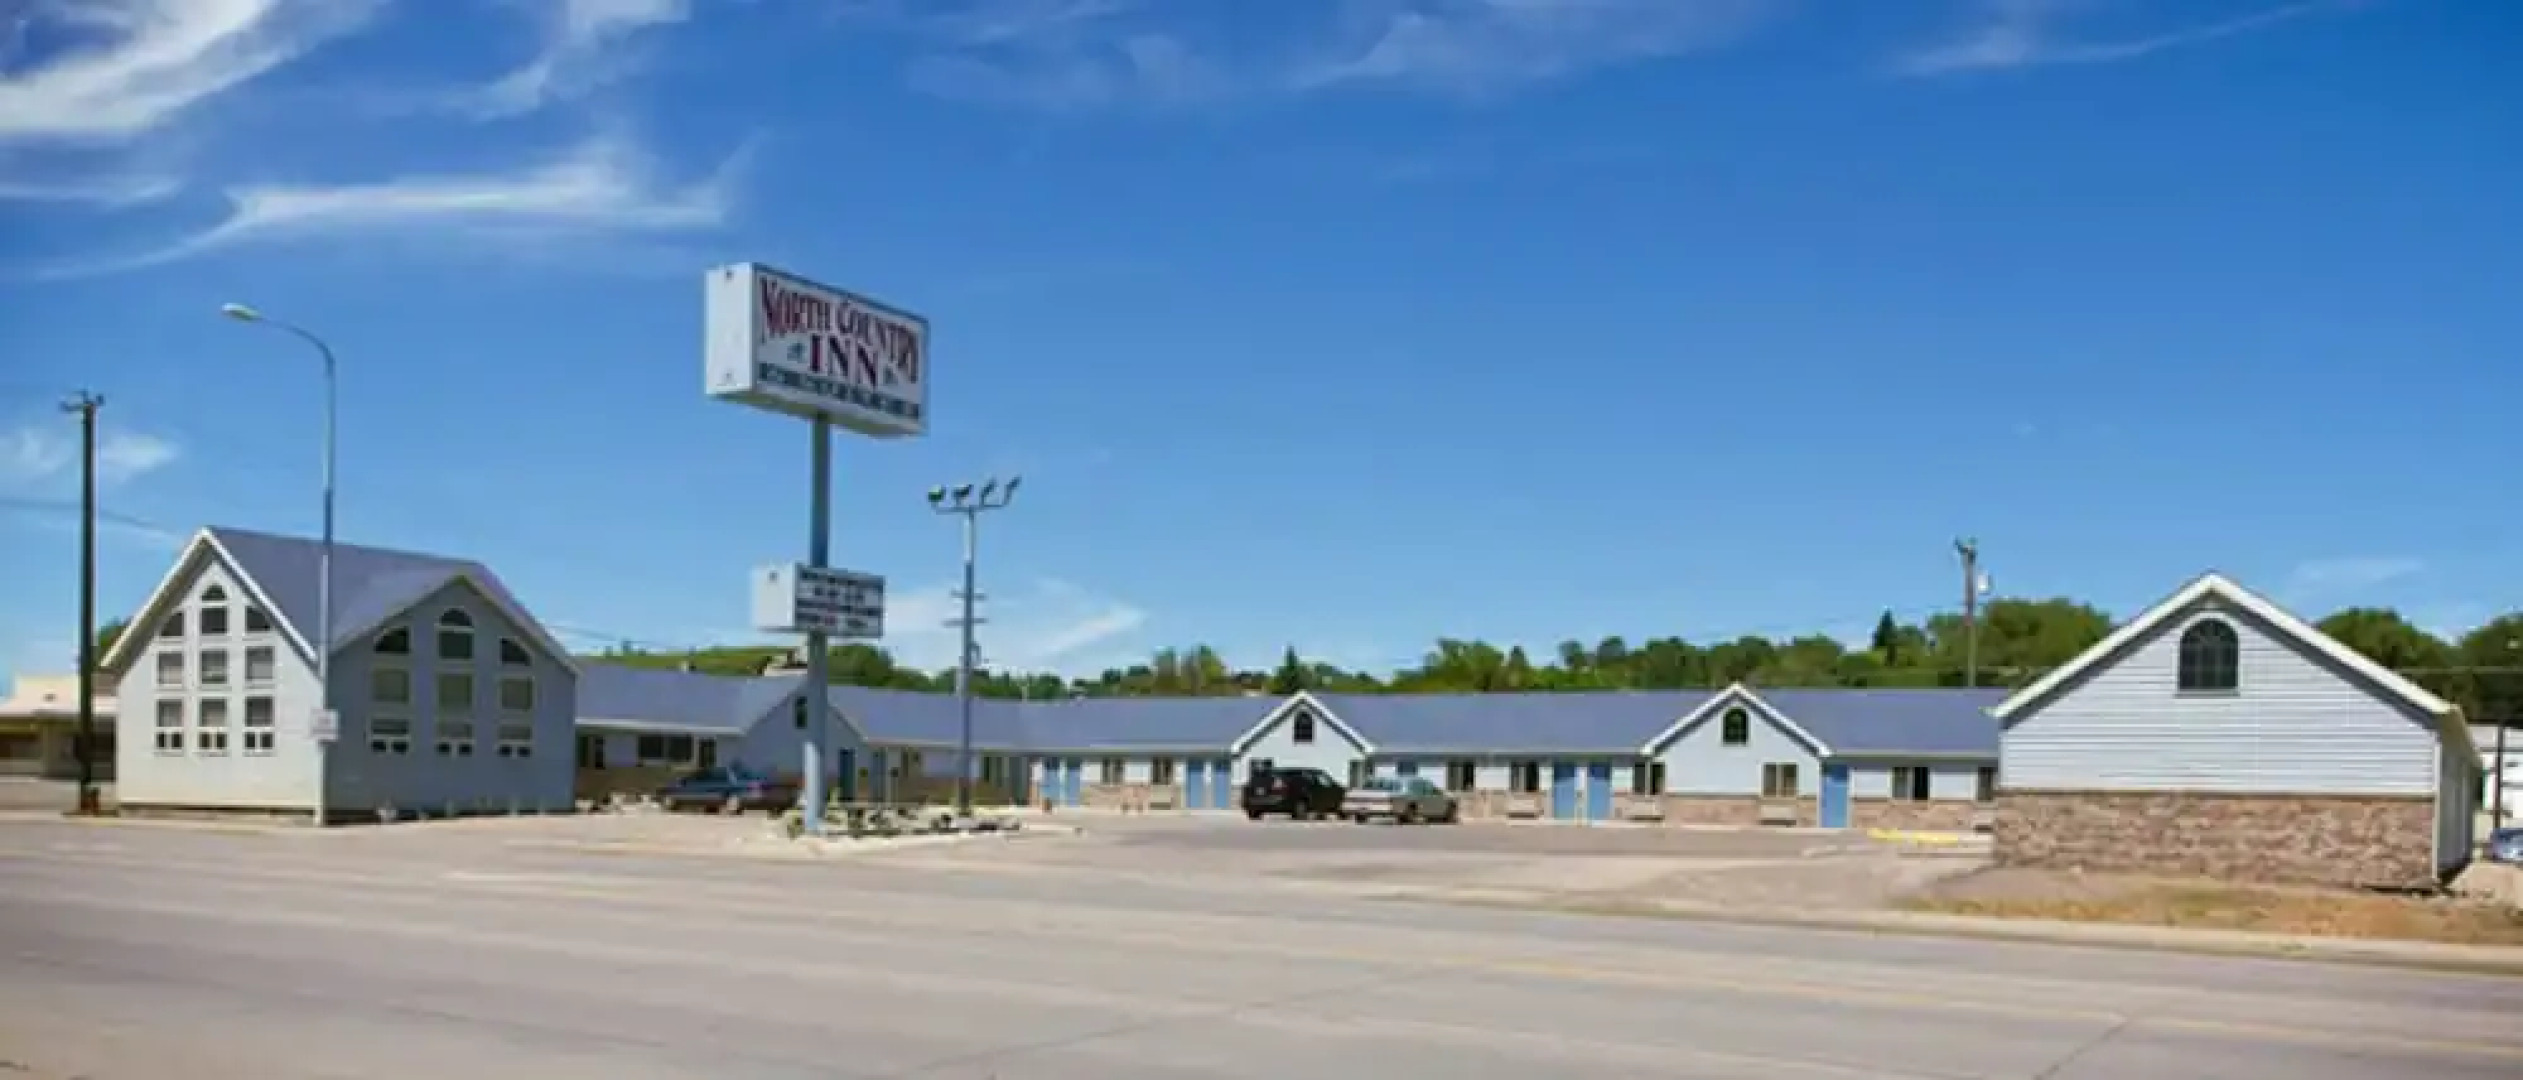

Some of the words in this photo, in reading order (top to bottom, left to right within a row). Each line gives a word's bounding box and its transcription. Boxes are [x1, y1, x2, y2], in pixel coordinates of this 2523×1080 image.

[760, 277, 831, 344] NORTH
[837, 301, 918, 384] COUNTRY
[810, 334, 879, 389] INN
